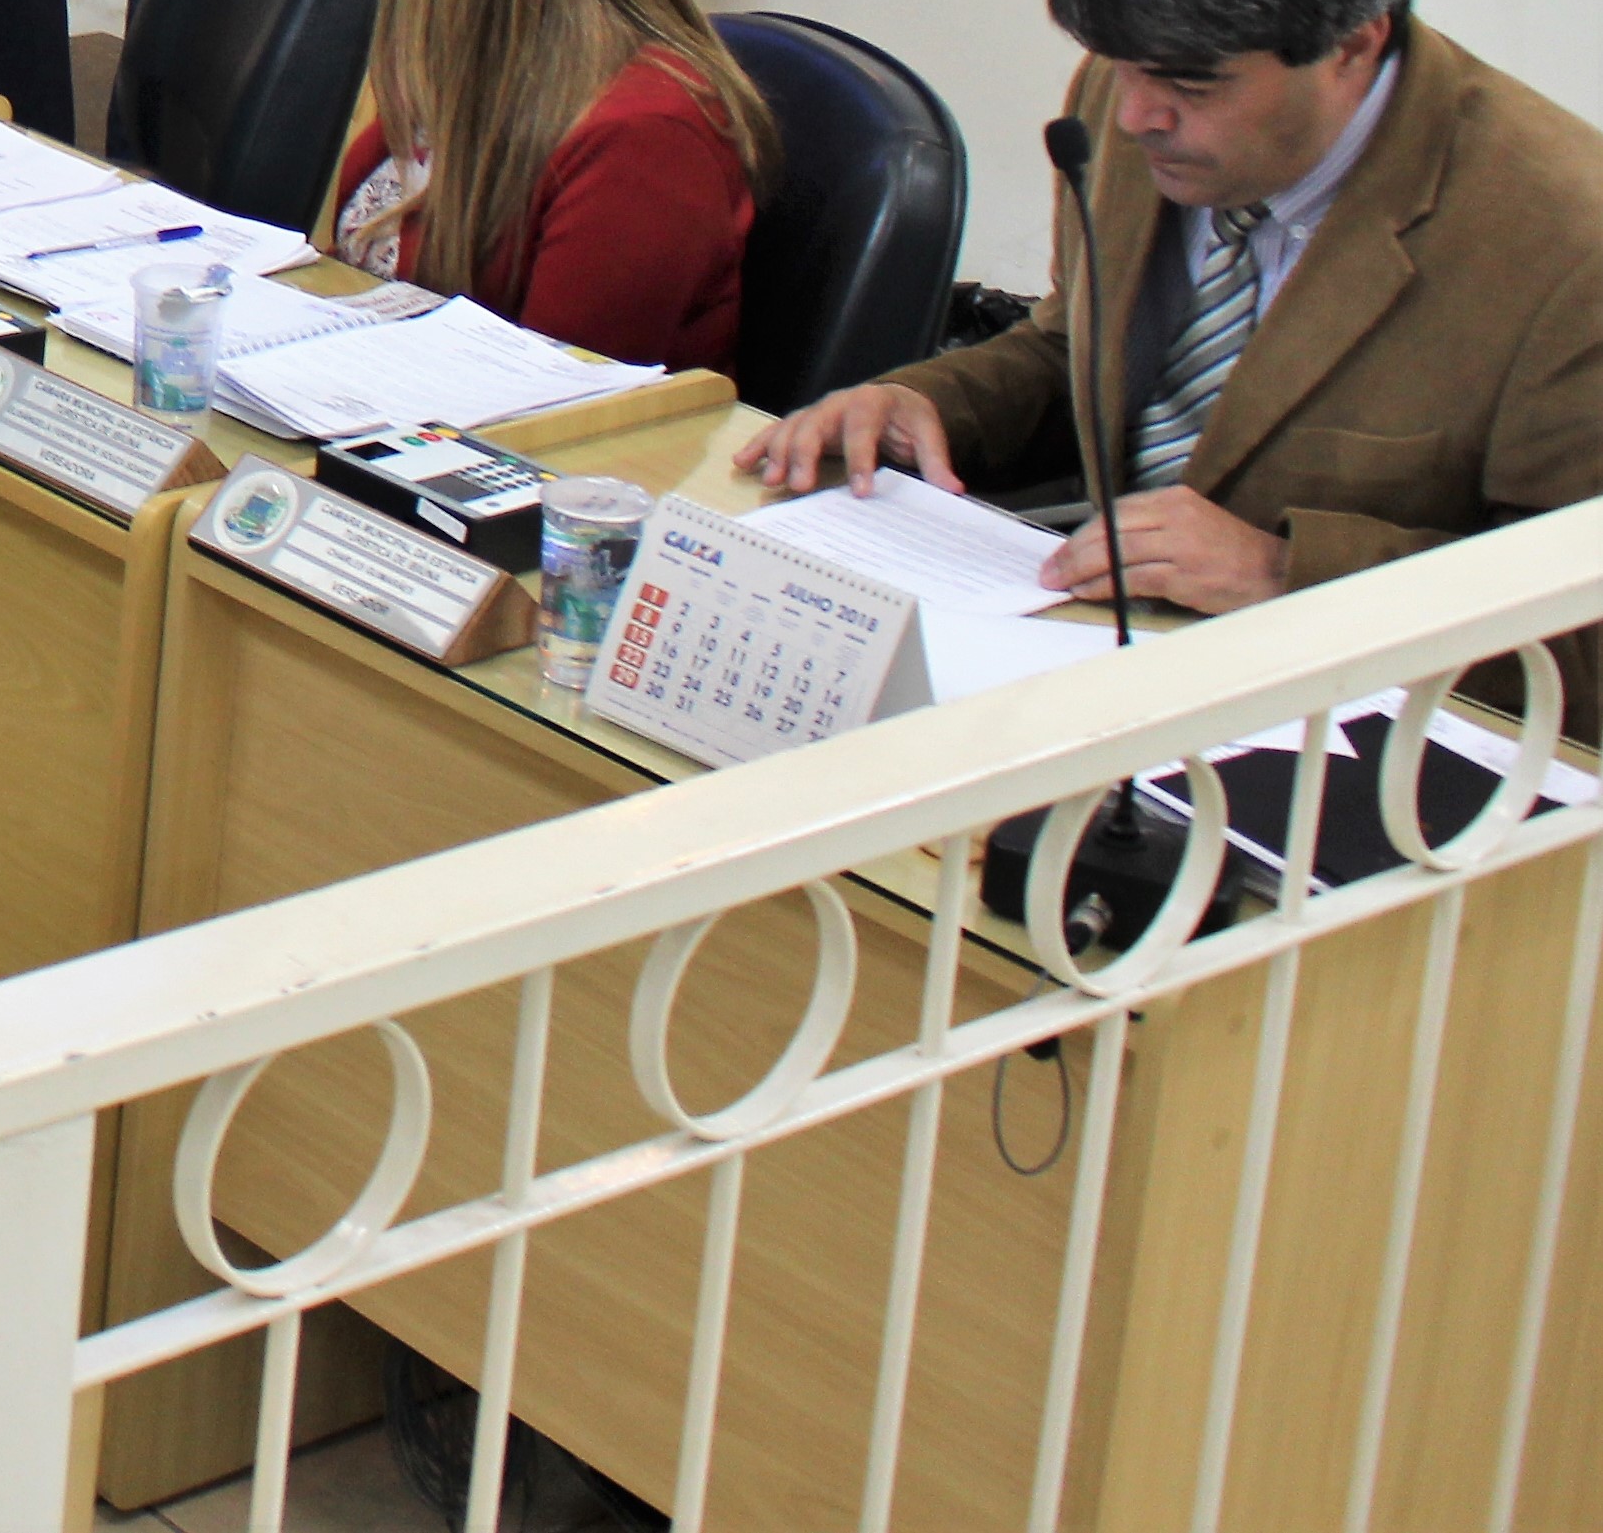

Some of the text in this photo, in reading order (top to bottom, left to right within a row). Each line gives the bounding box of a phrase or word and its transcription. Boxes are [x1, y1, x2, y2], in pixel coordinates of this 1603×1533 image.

[664, 530, 724, 567] CAIXA
[781, 582, 880, 633] JULHO 2018
